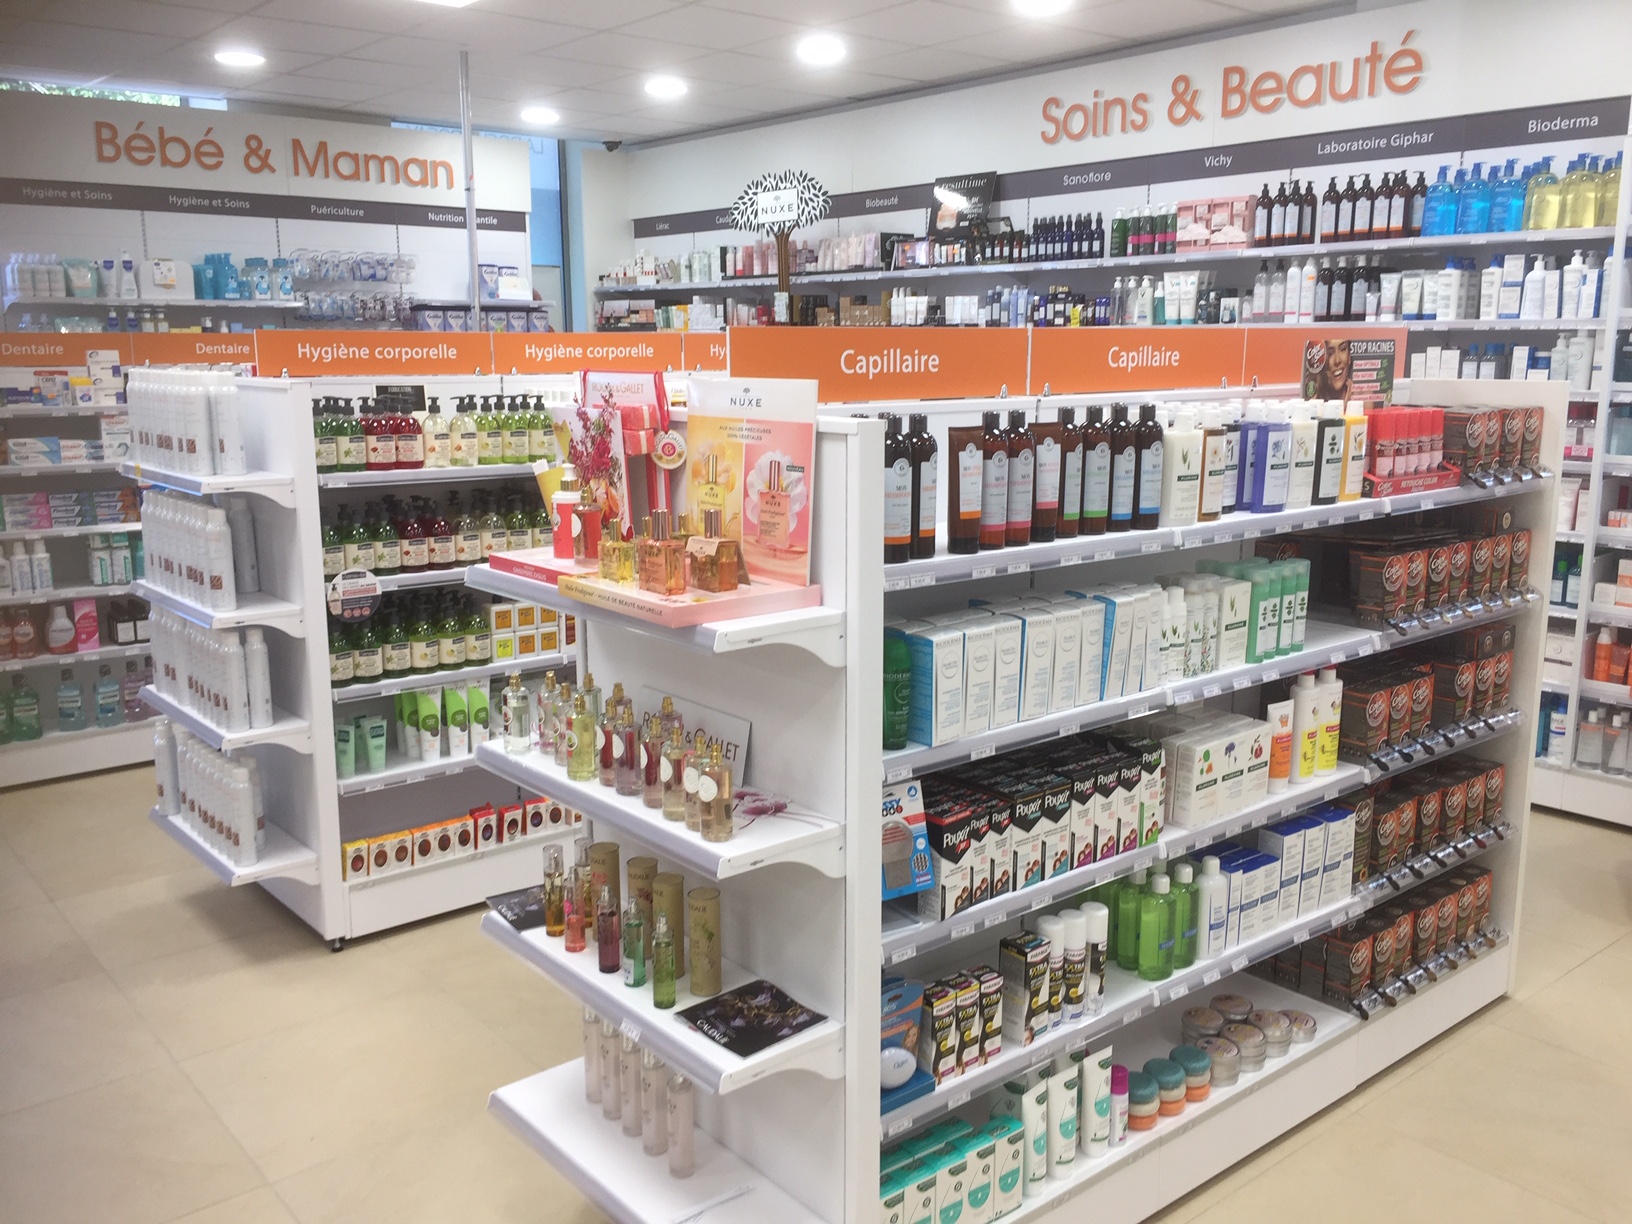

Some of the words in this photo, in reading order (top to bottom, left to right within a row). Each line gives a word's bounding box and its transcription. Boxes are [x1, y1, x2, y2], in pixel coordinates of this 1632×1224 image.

[1040, 89, 1149, 145] Soins
[1167, 74, 1203, 126] &
[1221, 29, 1424, 119] Beauté
[1527, 113, 1599, 134] Bioderma
[1317, 138, 1388, 155] Laboratoire
[1390, 130, 1434, 148] Giphar
[95, 121, 224, 170] Bébé
[243, 133, 276, 174] &
[292, 138, 454, 189] Maman
[1204, 153, 1233, 168] Vichy
[942, 176, 988, 190] resultime
[1063, 171, 1112, 186] Sanoflore
[22, 186, 68, 200] Hygiène
[70, 189, 81, 199] et
[84, 190, 113, 200] Soins
[169, 194, 210, 207] Hygiène
[211, 197, 222, 207] et
[224, 198, 250, 209] Soins
[865, 196, 899, 208] Biobeauté
[310, 204, 365, 217] Puériculture
[761, 203, 795, 216] NUXE
[428, 212, 464, 223] Nutrition
[655, 222, 670, 231] Liérac
[1, 342, 64, 356] Dentaire
[195, 342, 250, 355] Dentaire
[297, 342, 370, 362] Hygiène
[374, 343, 457, 362] corporelle
[524, 343, 583, 361] Hygiène
[586, 343, 654, 360] corporelle
[1350, 341, 1367, 354] STOP
[1367, 341, 1395, 353] RACINES
[840, 349, 940, 380] Capillaire
[1108, 346, 1180, 372] Capillaire
[730, 397, 762, 408] NUXE
[744, 426, 772, 434] PRÉCIEUSES
[619, 600, 636, 609] BEAUTÉ
[636, 604, 663, 616] NATURELLE
[685, 731, 692, 743] &
